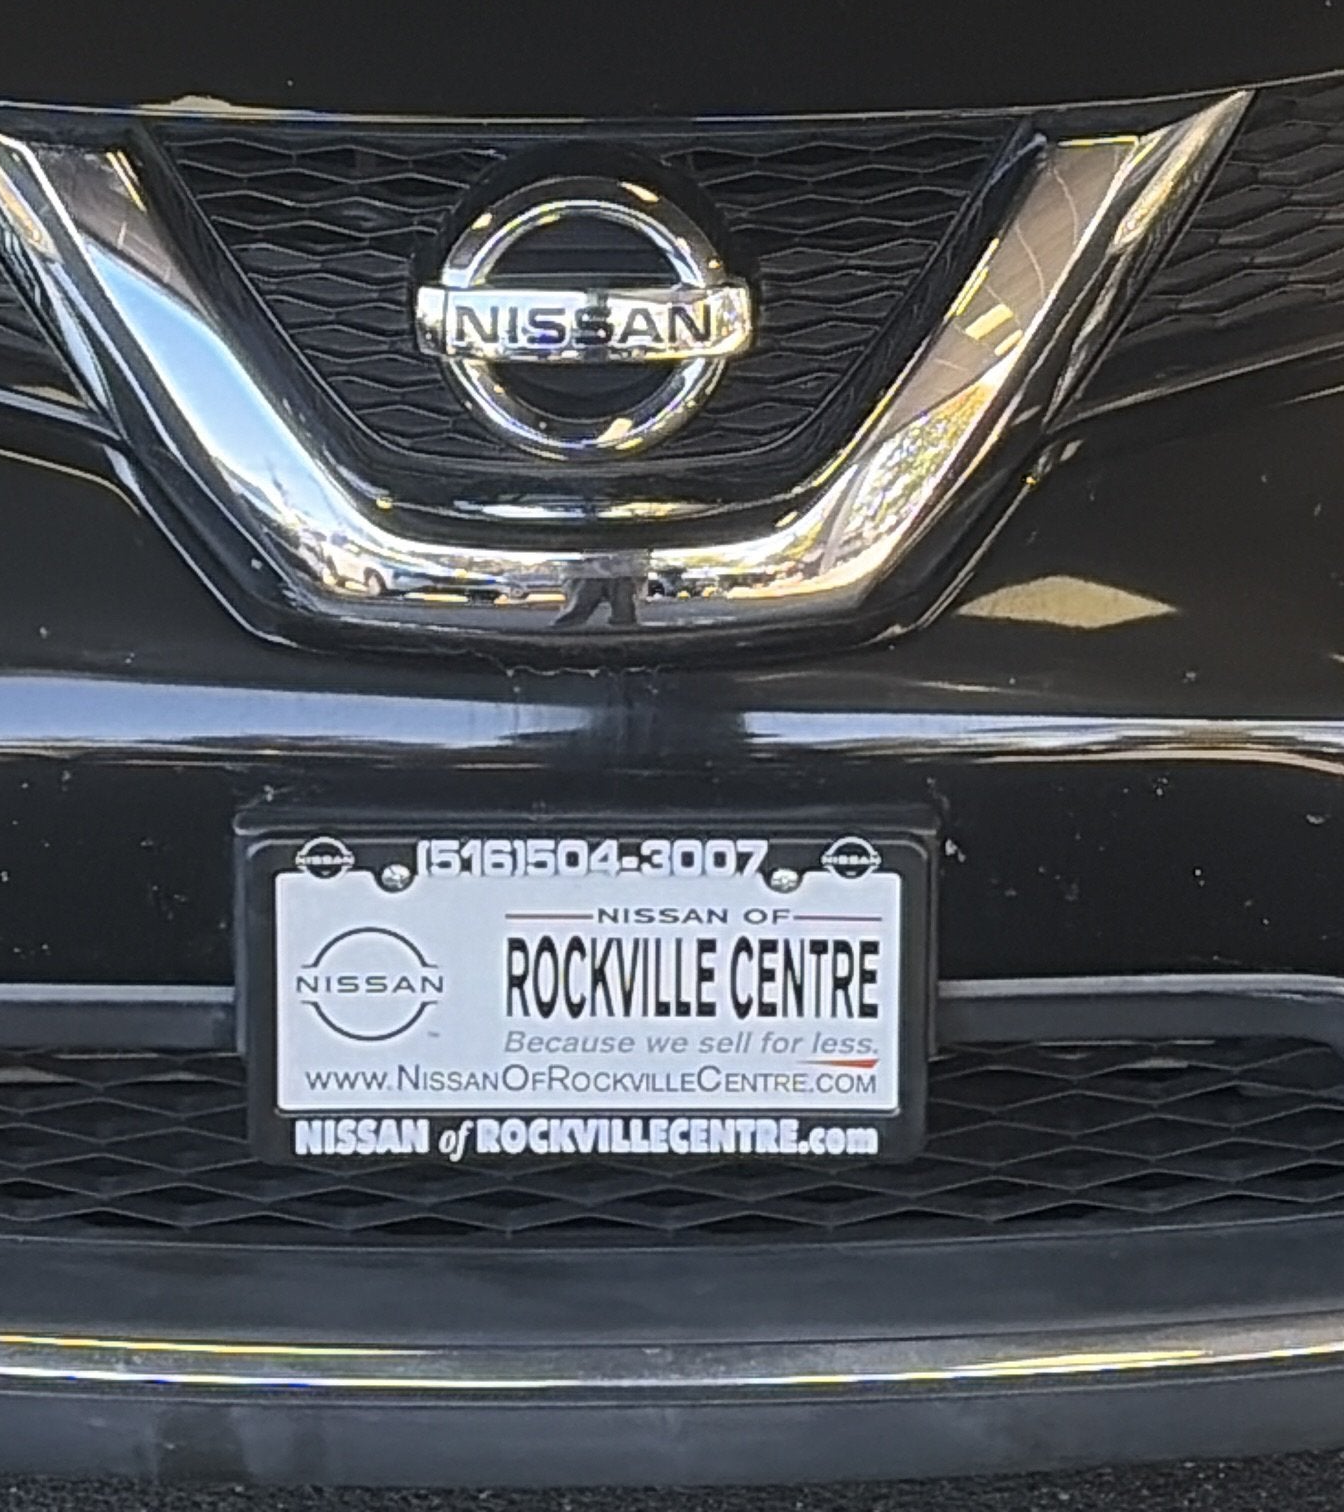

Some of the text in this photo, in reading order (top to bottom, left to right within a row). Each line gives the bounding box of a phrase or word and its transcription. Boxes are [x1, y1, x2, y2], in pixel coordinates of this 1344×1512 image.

[455, 305, 713, 345] NISSAN
[416, 839, 768, 876] (516)504-3007
[597, 908, 791, 924] NISSAN OF
[296, 975, 444, 994] NISSAN
[505, 935, 880, 1020] ROCKVILLE CENTRE
[504, 1031, 879, 1055] Because we sell for less.
[294, 1118, 880, 1162] NISSAN of ROCKVILLECENTRE.com
